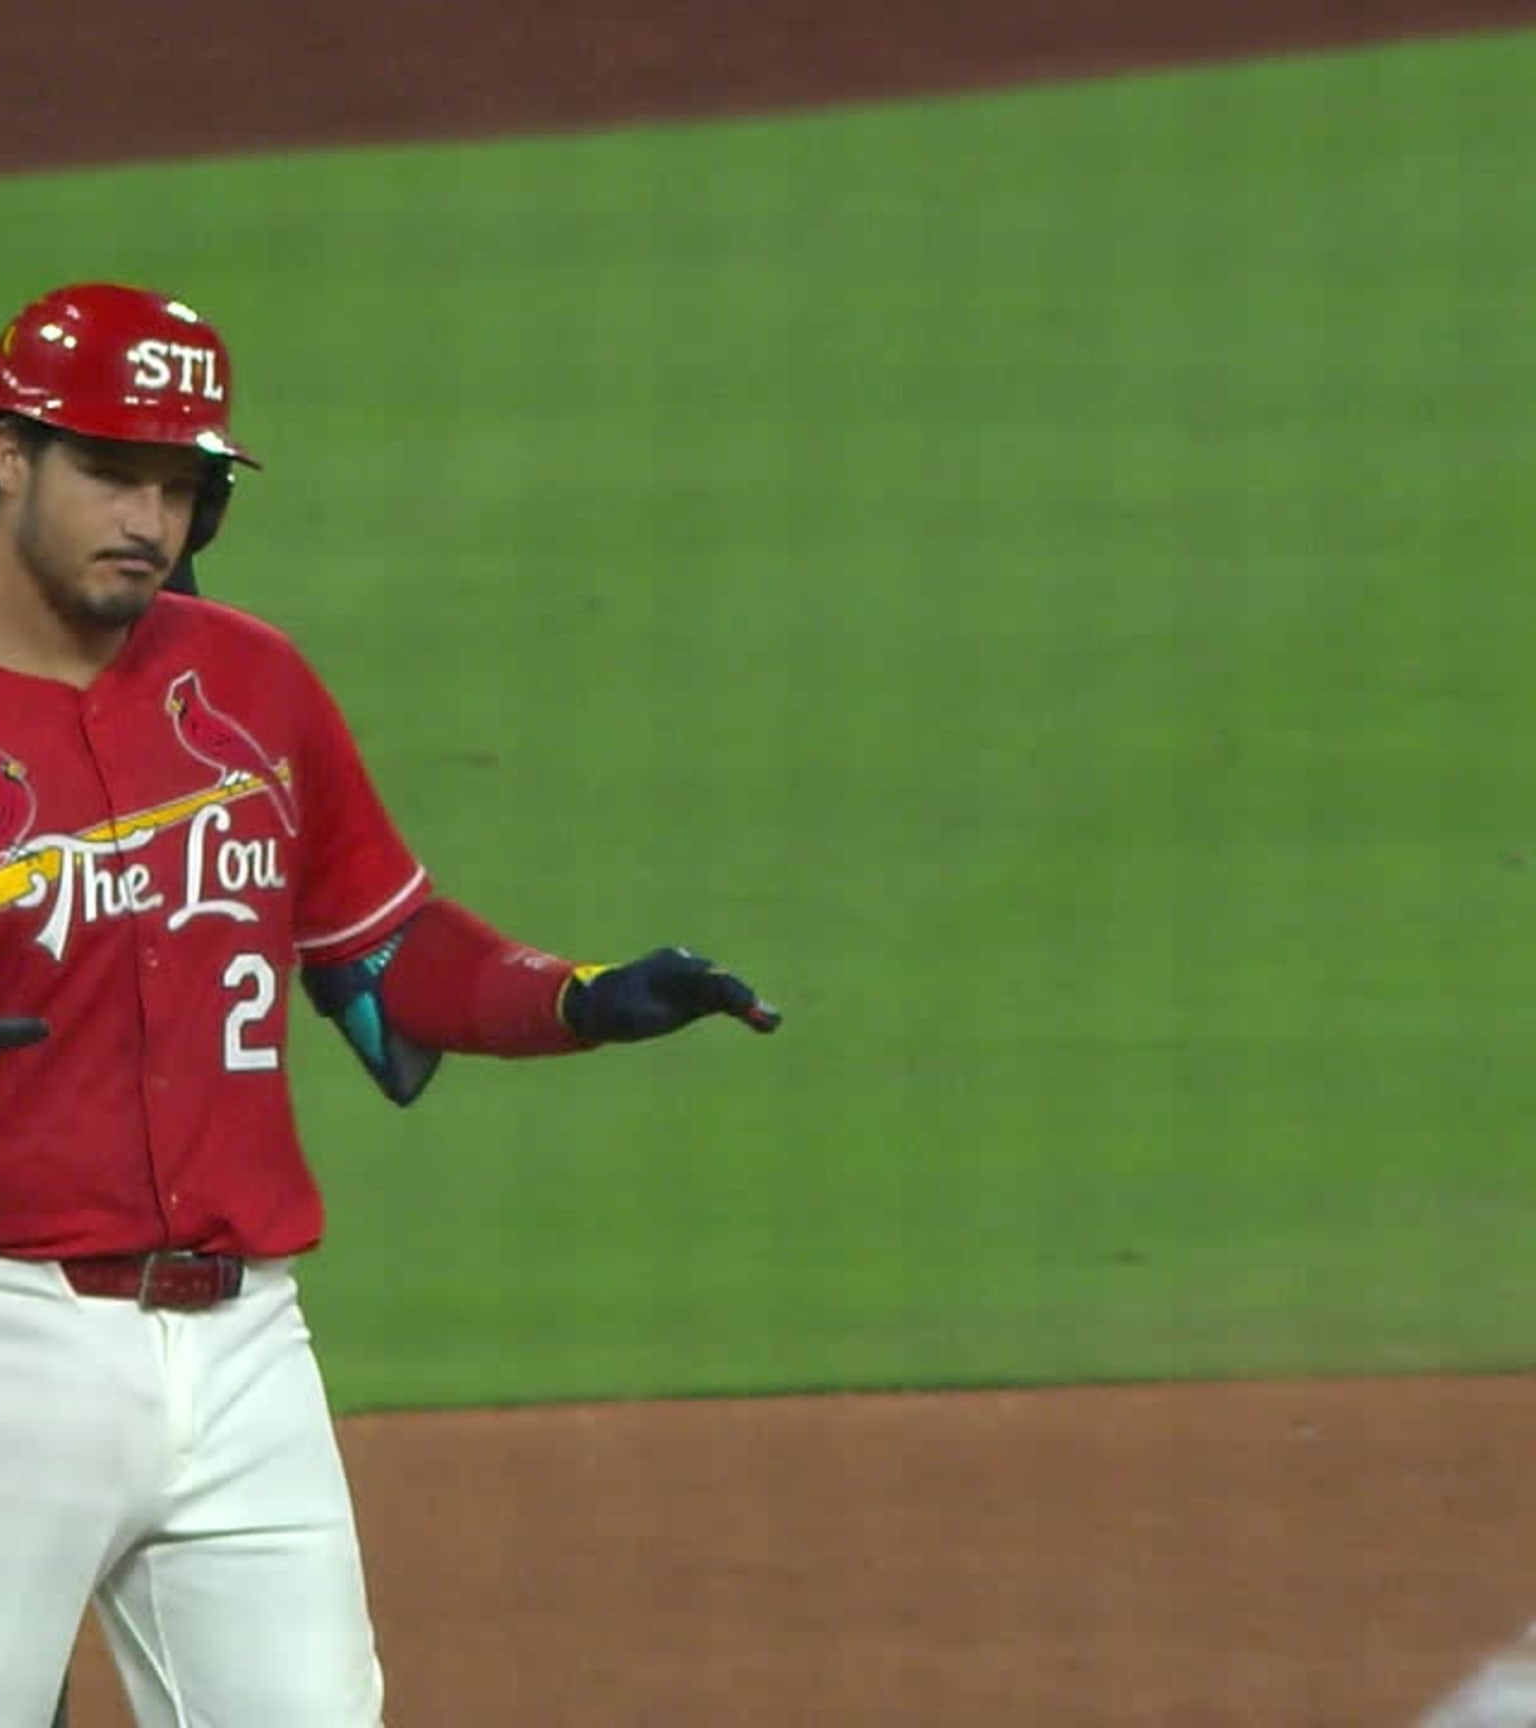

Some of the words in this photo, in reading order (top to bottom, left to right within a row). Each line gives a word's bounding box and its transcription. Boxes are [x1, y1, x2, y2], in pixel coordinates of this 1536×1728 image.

[127, 339, 223, 400] STL
[14, 828, 163, 962] The
[167, 803, 285, 931] Lou
[223, 953, 279, 1071] 2
